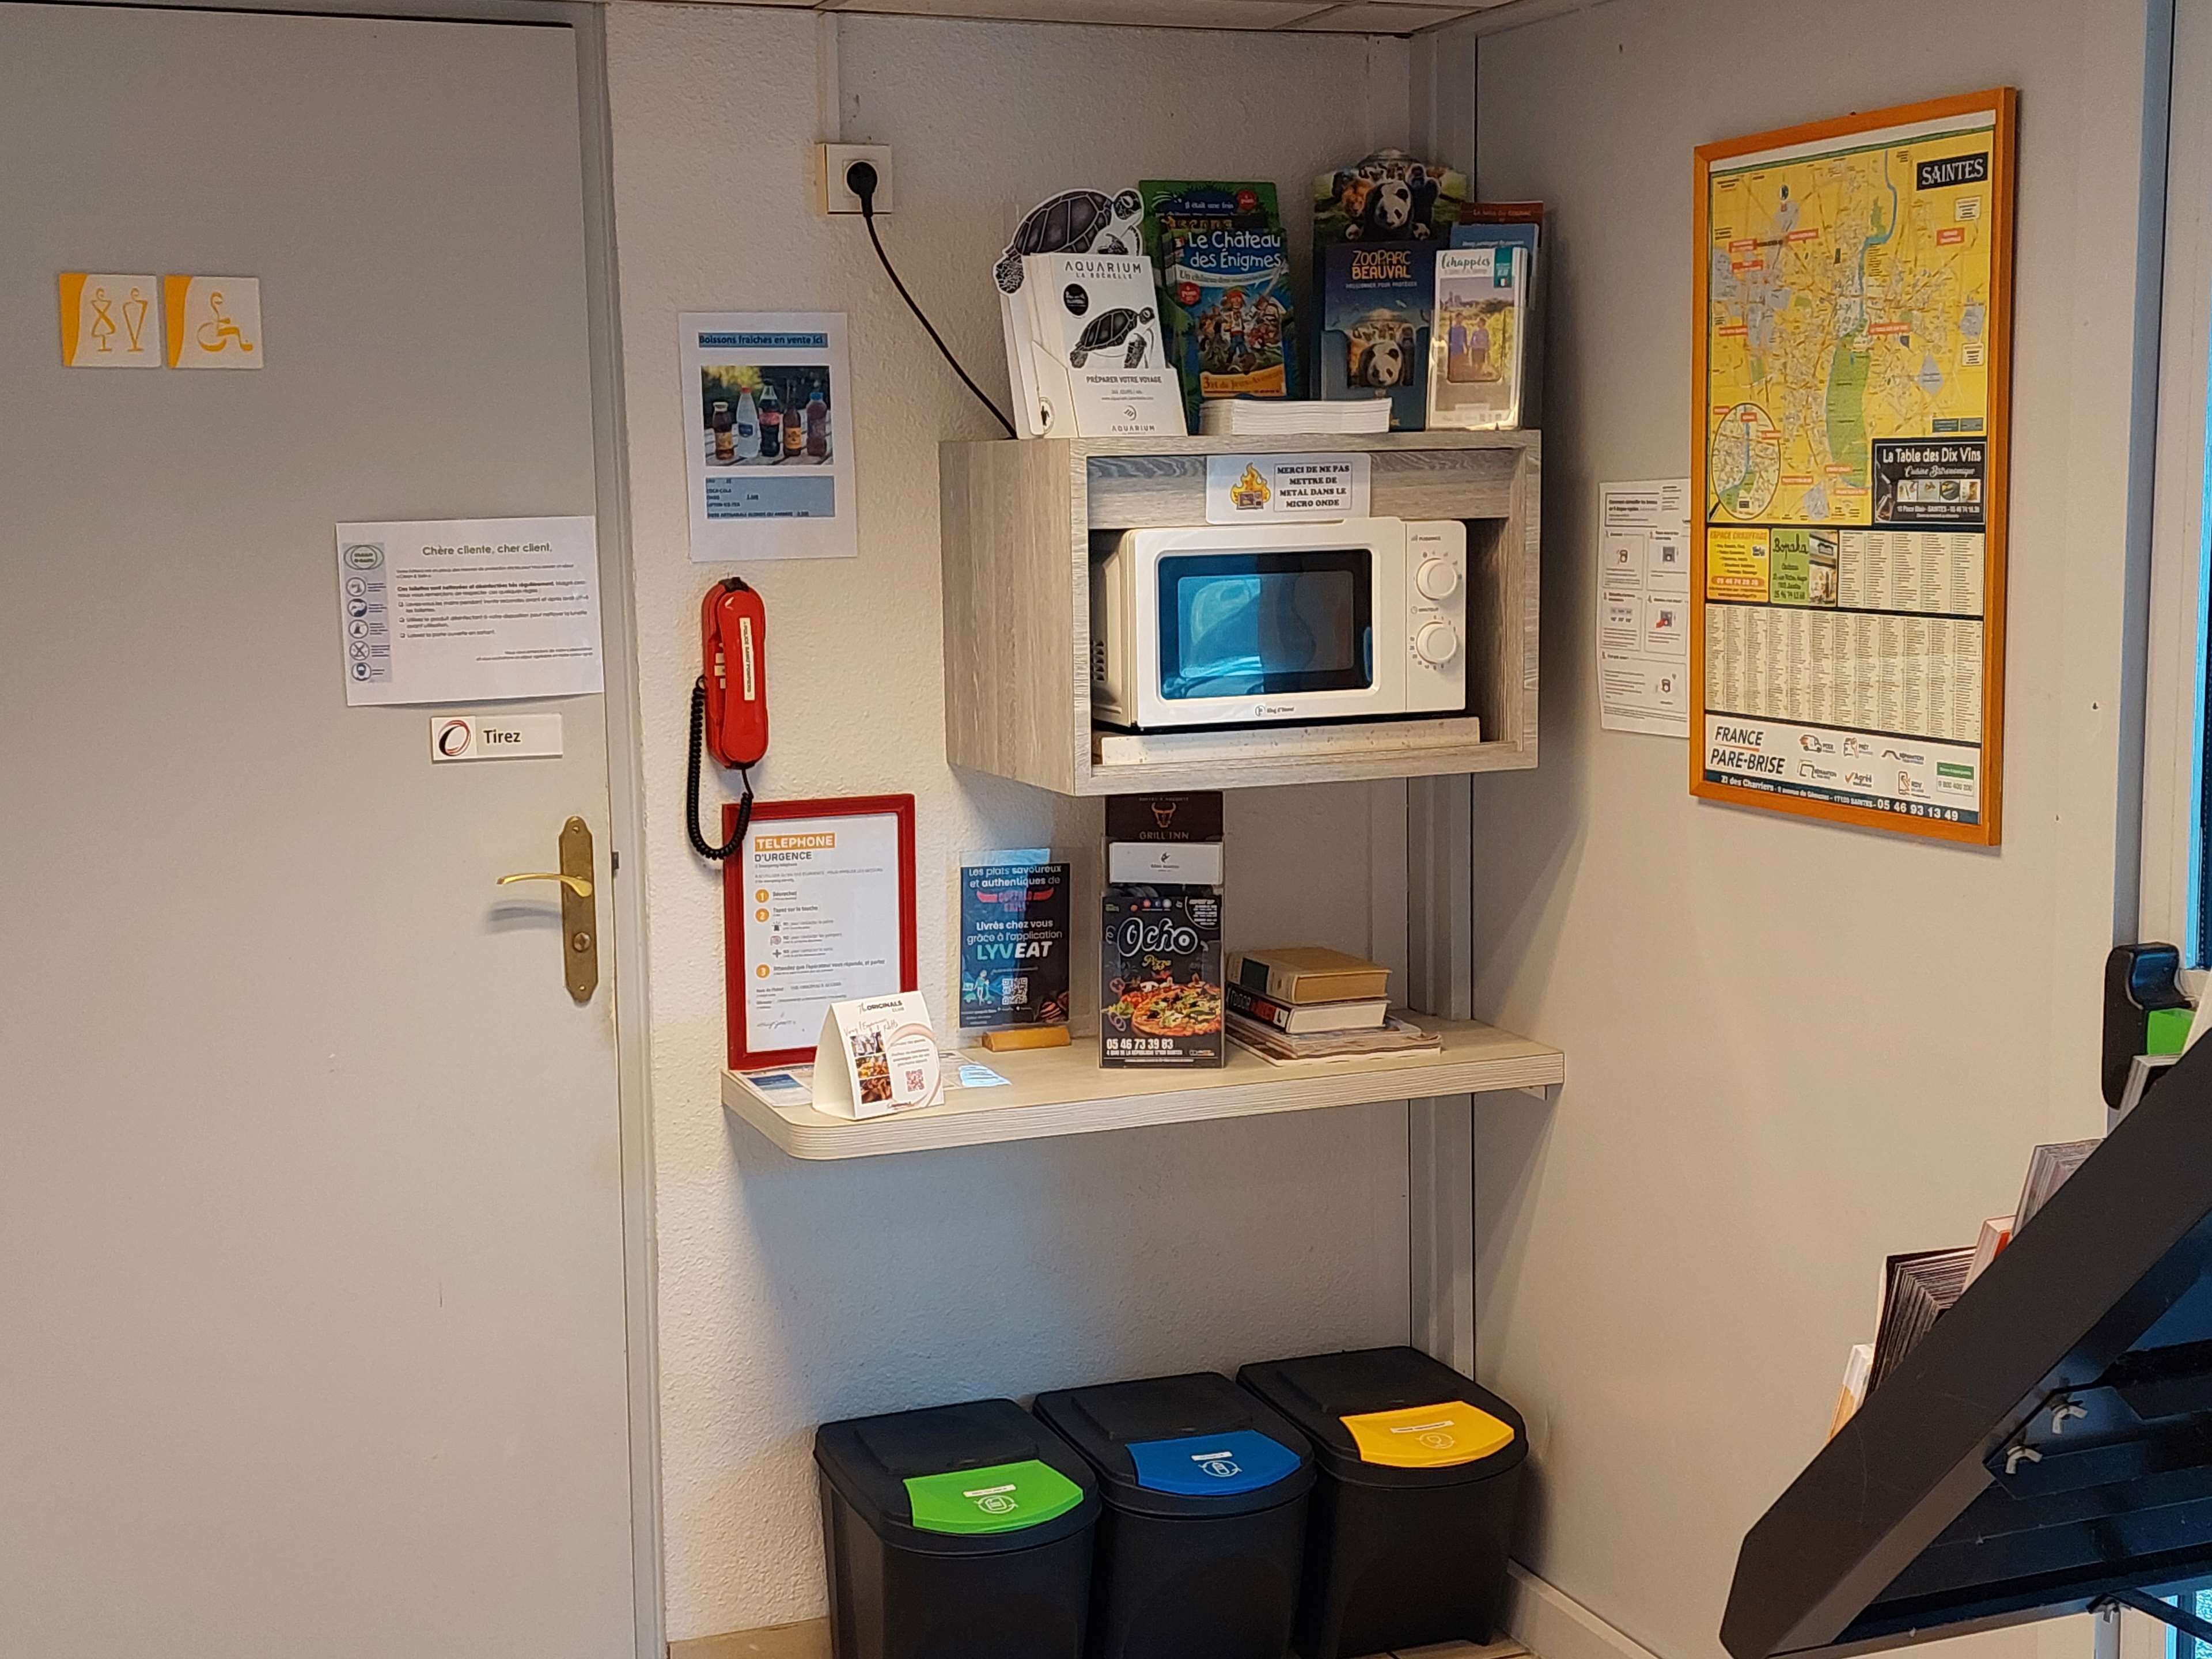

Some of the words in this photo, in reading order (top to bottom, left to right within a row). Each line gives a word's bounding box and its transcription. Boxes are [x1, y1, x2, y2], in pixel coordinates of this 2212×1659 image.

[1922, 158, 1984, 185] SAINTES
[1188, 232, 1209, 249] Le
[1212, 231, 1281, 249] Château
[1190, 251, 1217, 267] des
[1220, 248, 1281, 272] Énigmes
[1065, 261, 1141, 273] AQUARIUM
[1352, 266, 1411, 280] BEAUVAL
[699, 335, 736, 344] Boissons
[786, 336, 811, 344] vente
[1883, 448, 1894, 463] La
[1895, 448, 1921, 463] Table
[1922, 448, 1940, 463] des
[1941, 447, 1958, 463] Dix
[1959, 446, 1982, 462] Vins
[1277, 465, 1305, 474] MERCI
[422, 546, 454, 555] Chère
[457, 545, 494, 555] cliente,
[497, 544, 520, 553] cher
[522, 543, 552, 552] client,
[483, 729, 521, 744] Tirez
[1714, 726, 1764, 746] FRANCE
[1710, 748, 1785, 774] PARE-BRISE
[1729, 777, 1742, 786] des
[1743, 778, 1774, 791] Charriers
[1877, 799, 1890, 810] 05
[1893, 801, 1907, 813] 46
[1910, 804, 1923, 816] 93
[1927, 806, 1941, 819] 13
[1945, 809, 1959, 821] 49
[1139, 831, 1166, 840] GRILL
[1169, 831, 1189, 840] INN
[756, 835, 834, 850] TELEPHONE
[755, 851, 812, 862] D'URGENCE
[969, 868, 983, 876] Les
[986, 868, 1009, 878] plats
[1012, 865, 1062, 874] savoureux
[969, 880, 979, 888] et
[982, 877, 1046, 888] authentiques
[1048, 876, 1060, 884] de
[760, 892, 764, 901] 1
[760, 912, 766, 920] 2
[976, 921, 1004, 931] Livrés
[1006, 920, 1028, 929] chez
[1030, 920, 1053, 928] vous
[967, 933, 995, 945] grâce
[997, 932, 1004, 941] à
[1006, 930, 1062, 942] l'application
[1117, 917, 1198, 957] Ocho
[977, 941, 1053, 960] LYVEAT
[1142, 954, 1172, 971] Pizza
[760, 968, 766, 976] 3
[867, 1000, 903, 1010] ORIGINALS
[1107, 1039, 1119, 1050] 05
[1120, 1039, 1132, 1050] 46
[1134, 1039, 1146, 1050] 73
[1147, 1039, 1160, 1049] 39
